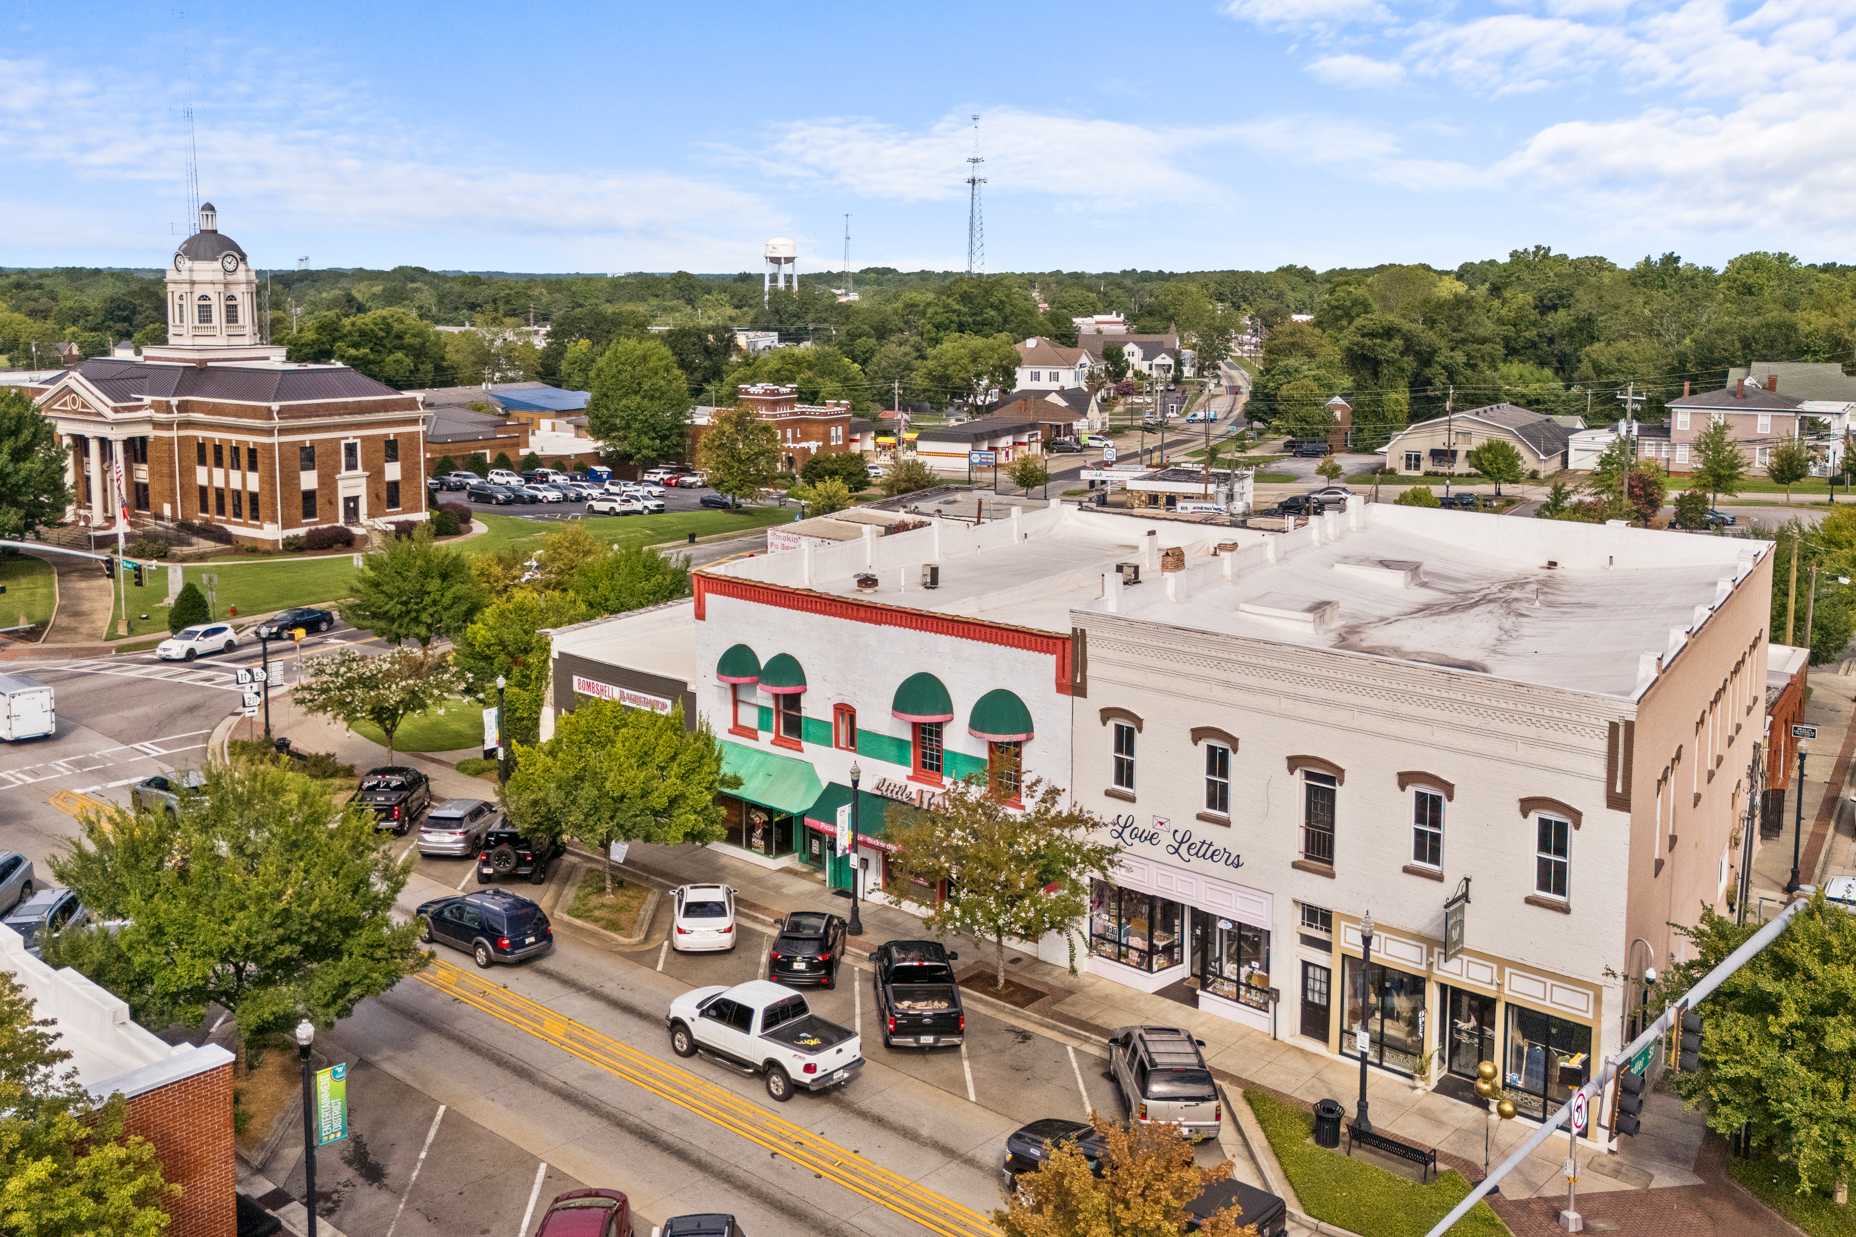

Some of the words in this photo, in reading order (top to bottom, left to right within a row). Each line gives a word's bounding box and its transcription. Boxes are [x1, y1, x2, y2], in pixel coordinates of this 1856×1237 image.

[577, 678, 614, 701] BOMBSHELL
[874, 777, 915, 802] Little
[1110, 814, 1161, 847] Love
[1166, 829, 1245, 869] Letters
[319, 1074, 333, 1137] ENTERTAINMENT
[330, 1099, 342, 1133] DISTRICT
